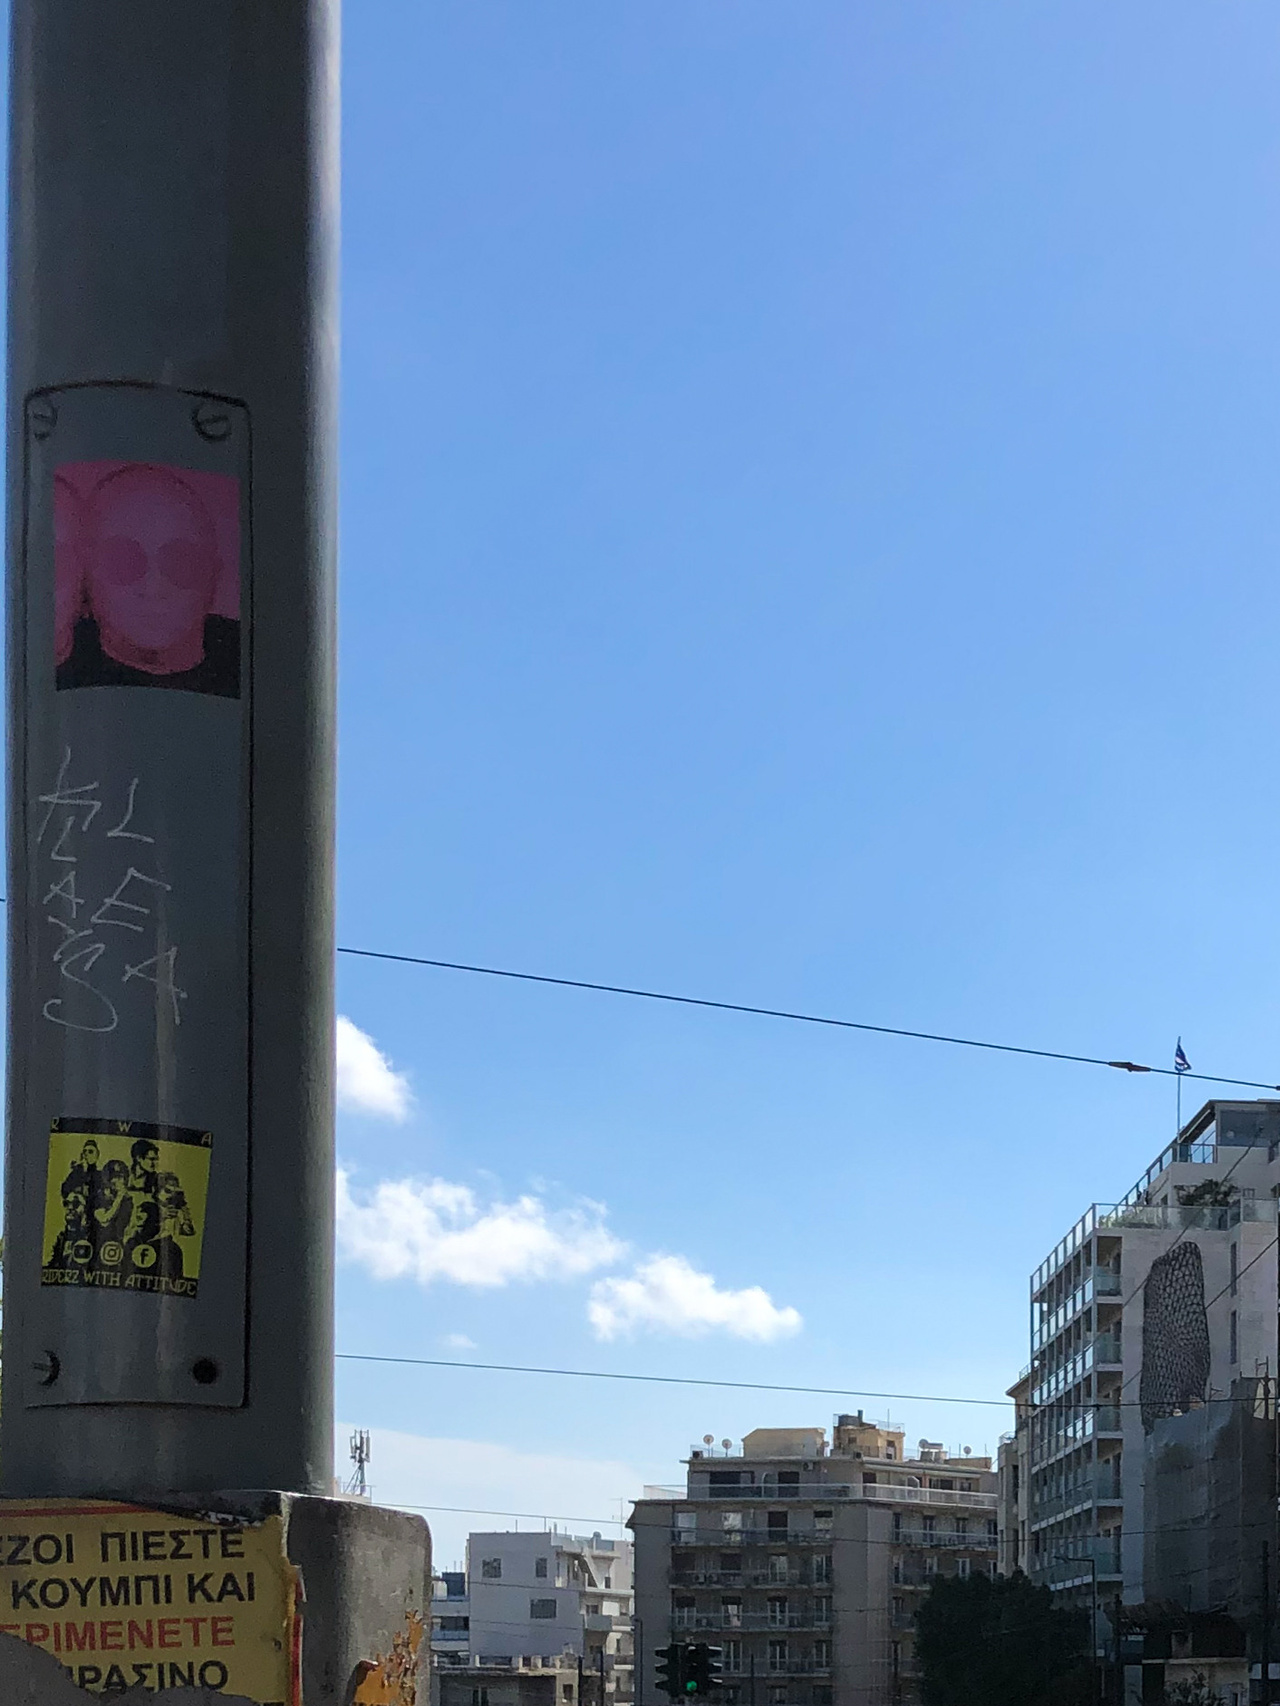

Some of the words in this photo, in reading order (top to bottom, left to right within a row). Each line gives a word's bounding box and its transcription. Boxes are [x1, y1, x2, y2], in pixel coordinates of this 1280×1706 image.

[117, 1121, 133, 1132] W
[200, 1131, 213, 1145] A
[83, 1270, 122, 1287] WITH
[124, 1274, 198, 1295] ATTITUDE
[0, 1533, 74, 1566] ΖΟΙ
[100, 1528, 246, 1564] ΠΙΕΣΤΕ
[11, 1574, 172, 1610] ΚΟΥΜΠΙ
[187, 1571, 256, 1605] ΚΑΙ
